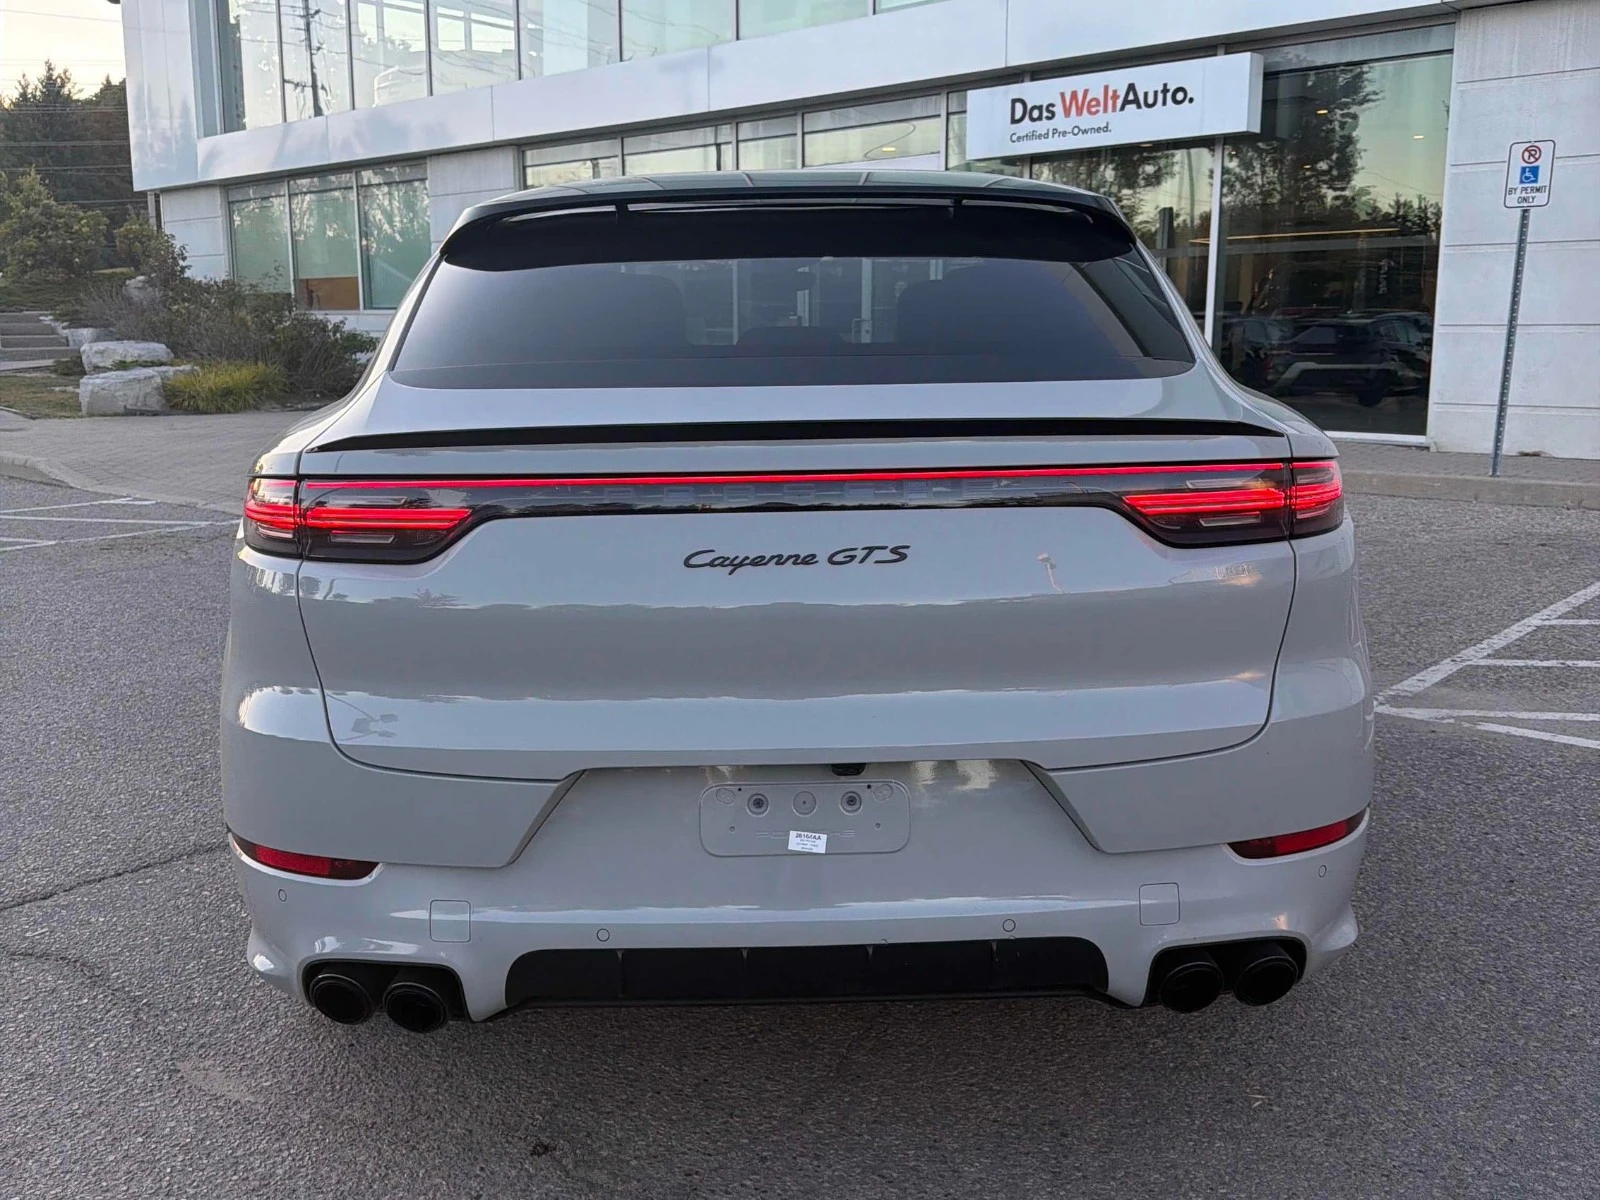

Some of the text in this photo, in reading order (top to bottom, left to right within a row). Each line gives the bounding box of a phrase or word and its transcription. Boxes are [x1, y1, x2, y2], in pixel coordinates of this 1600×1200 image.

[1010, 122, 1112, 143] Certified Pre-Owned.
[1508, 185, 1547, 195] BY PERMIT
[1517, 195, 1536, 204] ONLY
[683, 545, 911, 575] Cayenne GTS
